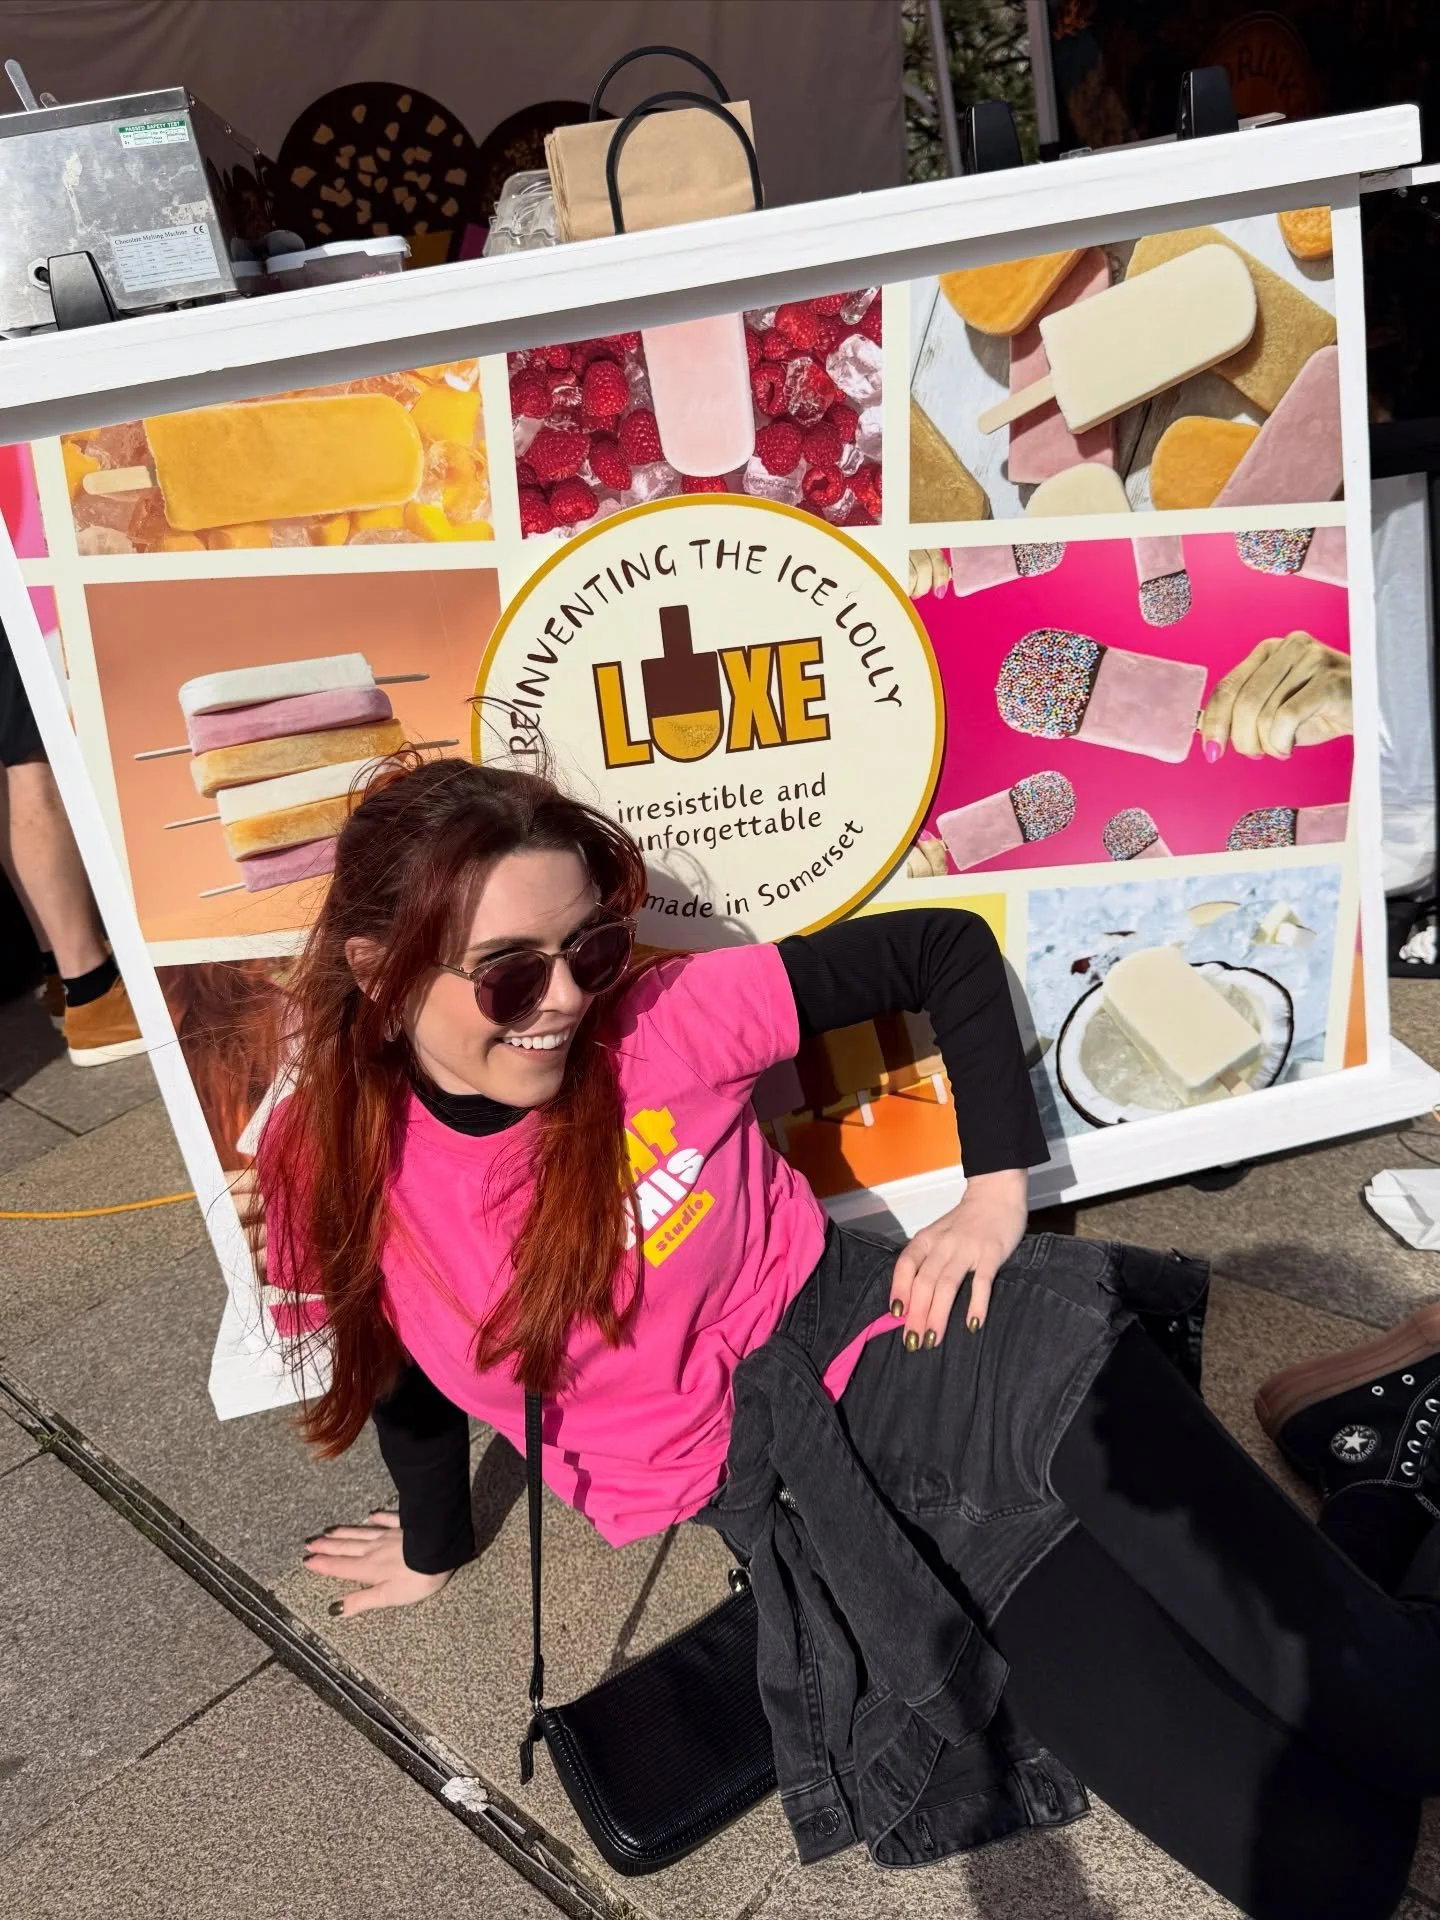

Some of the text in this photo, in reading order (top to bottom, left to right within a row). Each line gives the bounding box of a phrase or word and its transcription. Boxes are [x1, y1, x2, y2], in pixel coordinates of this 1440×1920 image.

[114, 229, 188, 246] Chocolate Melting Machine
[509, 538, 902, 755] REINVENTING THE ICE LOLLY
[592, 606, 831, 770] LUXE
[617, 771, 826, 824] irresistible and
[641, 819, 864, 918] made in Somerset
[655, 1199, 704, 1252] studio
[1340, 1439, 1376, 1460] CONVERSE
